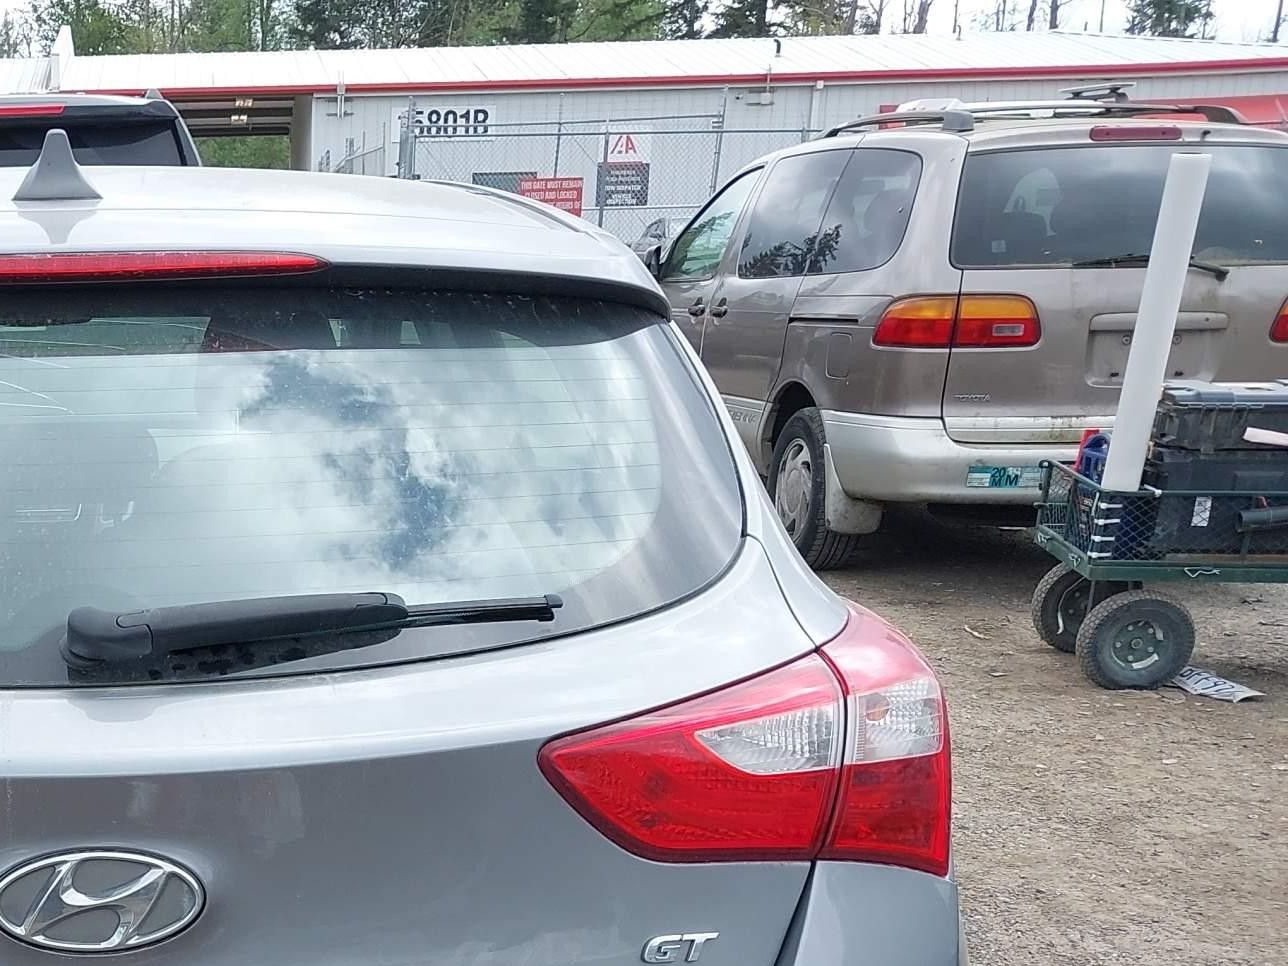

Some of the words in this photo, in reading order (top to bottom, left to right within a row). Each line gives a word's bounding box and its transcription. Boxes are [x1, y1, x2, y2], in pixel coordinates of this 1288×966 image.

[521, 181, 532, 191] THIS
[533, 181, 546, 190] GATE
[547, 180, 561, 189] MUST
[545, 191, 556, 200] AND
[557, 190, 578, 199] LOCKED
[642, 931, 719, 964] GT
